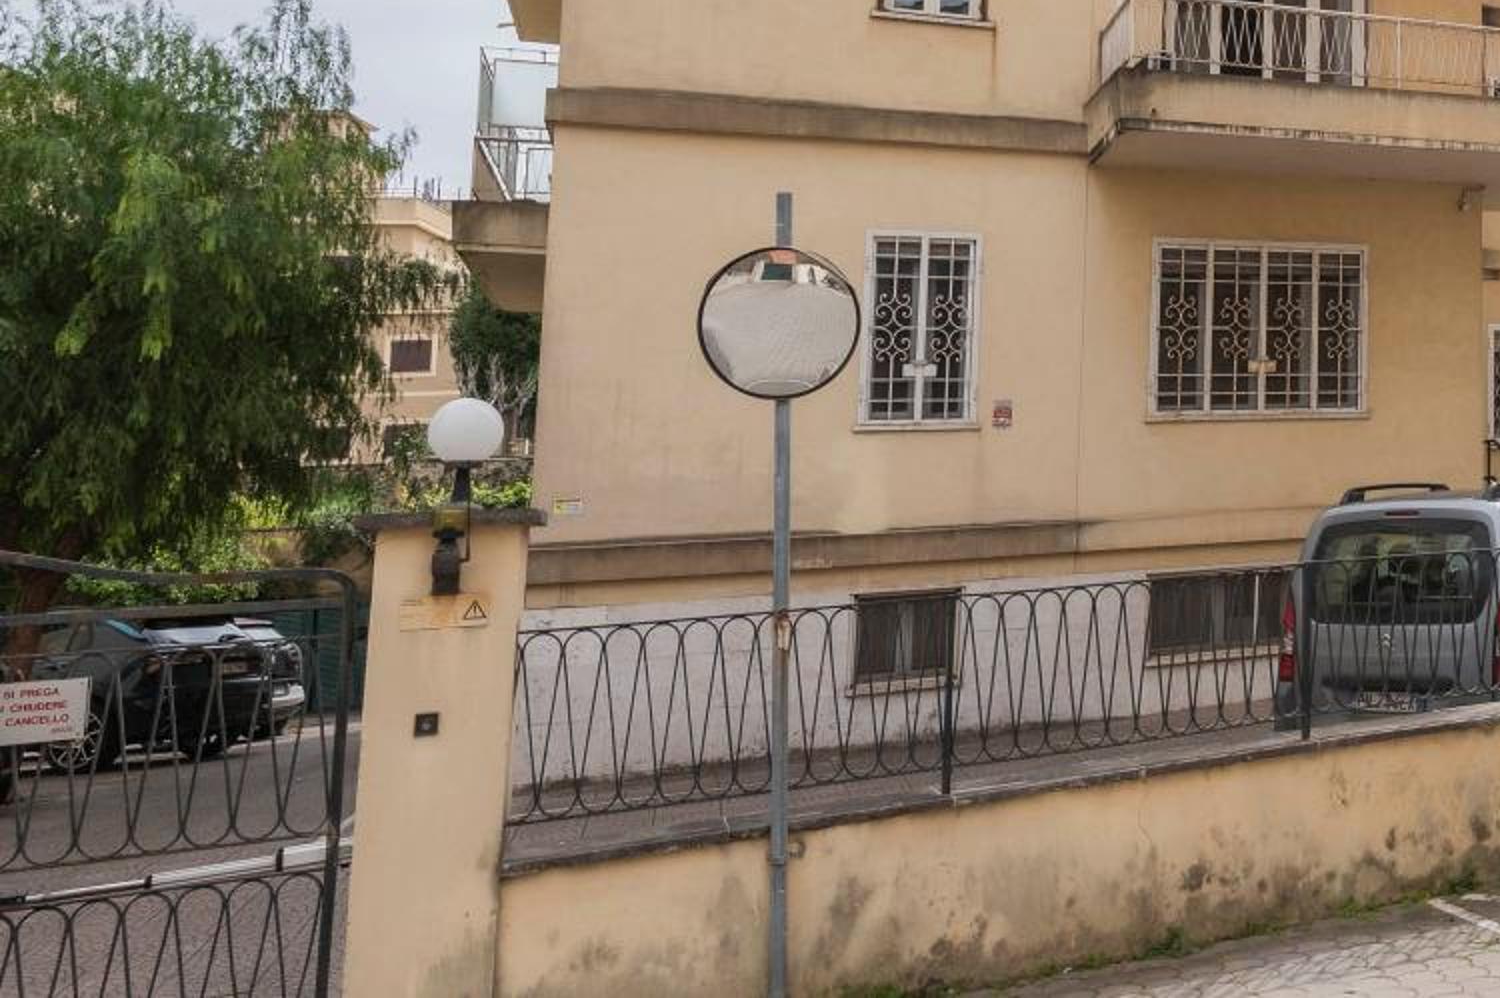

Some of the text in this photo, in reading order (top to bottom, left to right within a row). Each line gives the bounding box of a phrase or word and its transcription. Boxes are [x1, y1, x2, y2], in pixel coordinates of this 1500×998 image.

[20, 687, 60, 699] PREGA
[9, 701, 68, 713] CHIUDERE
[5, 713, 70, 727] CANCELLO
